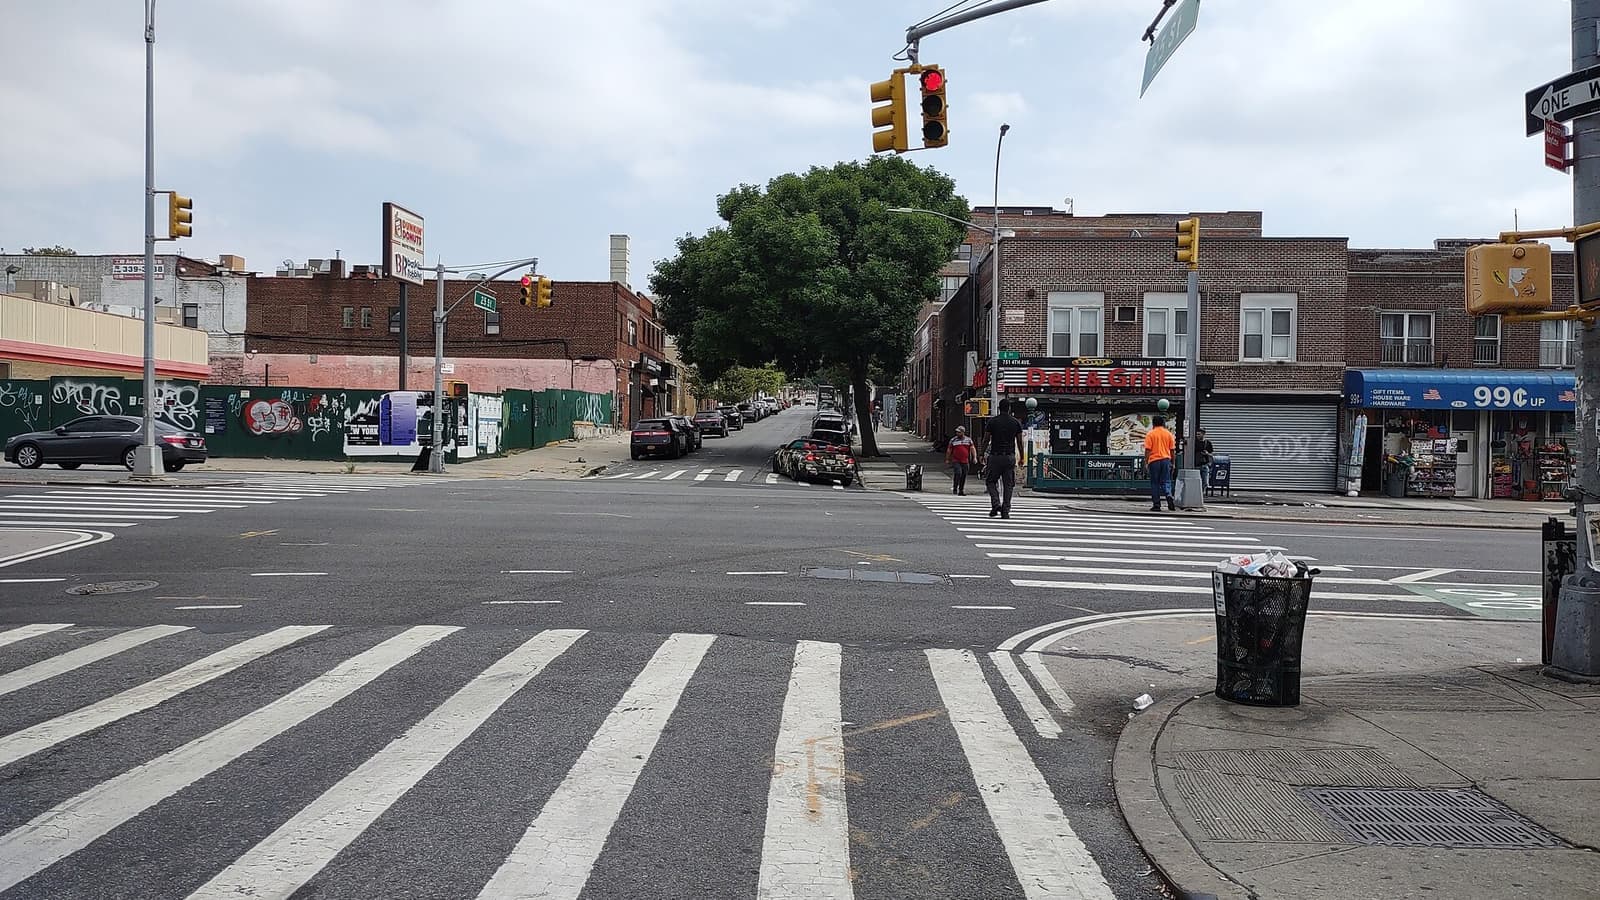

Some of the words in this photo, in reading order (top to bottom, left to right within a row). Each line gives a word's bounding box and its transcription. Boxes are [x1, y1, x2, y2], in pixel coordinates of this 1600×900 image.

[1541, 89, 1570, 116] ONE
[1026, 367, 1084, 387] Deli
[1086, 369, 1104, 387] &
[1108, 367, 1166, 387] Grill
[1473, 386, 1528, 408] 99¢
[1530, 397, 1546, 407] UP
[1088, 460, 1116, 469] Subway
